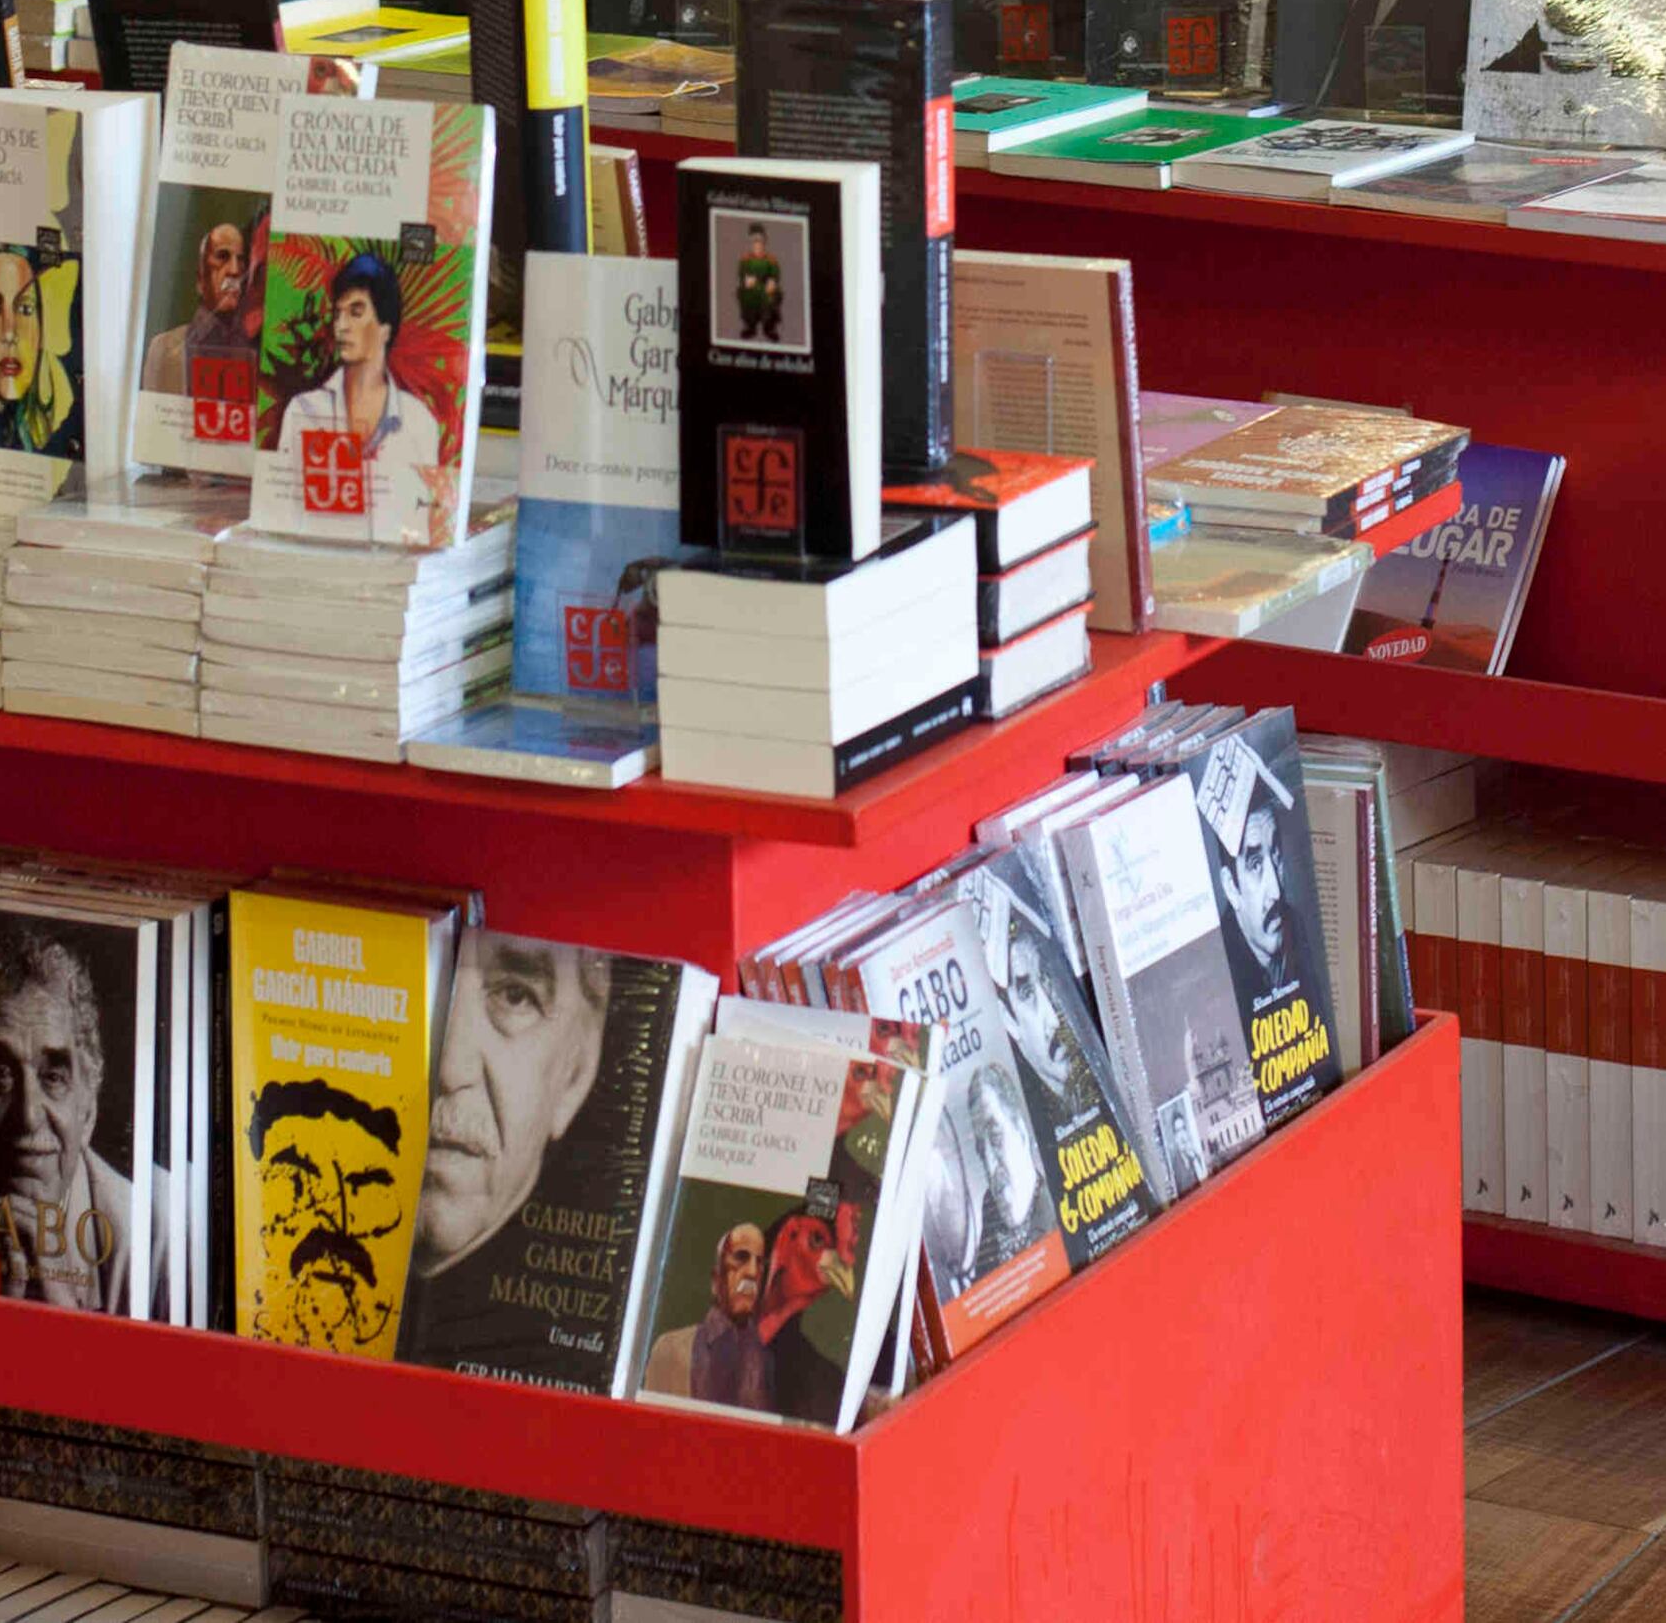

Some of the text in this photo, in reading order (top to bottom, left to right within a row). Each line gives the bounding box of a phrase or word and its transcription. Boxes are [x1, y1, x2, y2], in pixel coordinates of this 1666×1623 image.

[179, 88, 221, 110] TIENE
[200, 71, 271, 95] CORONEL
[18, 130, 40, 150] DE
[290, 108, 406, 136] CRÓNICA DE
[289, 131, 410, 159] UNA MUERTE
[288, 153, 399, 178] ANUNCIADA
[1486, 507, 1523, 530] DE
[1366, 635, 1428, 662] NOVEDAD
[293, 928, 366, 972] GABRIEL
[253, 967, 410, 1025] GARCÍA MÁRQUEZ
[898, 957, 969, 1026] GABO
[1251, 998, 1310, 1060] SOLEDAD
[1260, 1015, 1331, 1094] COMPAÑÍA
[710, 1061, 839, 1097] EL CORONEL NO
[708, 1081, 825, 1118] TIENE QUIEN LE
[1057, 1124, 1119, 1191] SOLEDAD
[1076, 1141, 1144, 1223] COMPAÑÍA
[521, 1201, 622, 1244] GABRIEL
[525, 1242, 615, 1283] GARCÍA
[489, 1273, 611, 1321] MÁRQUEZ
[548, 1325, 605, 1353] Una vida
